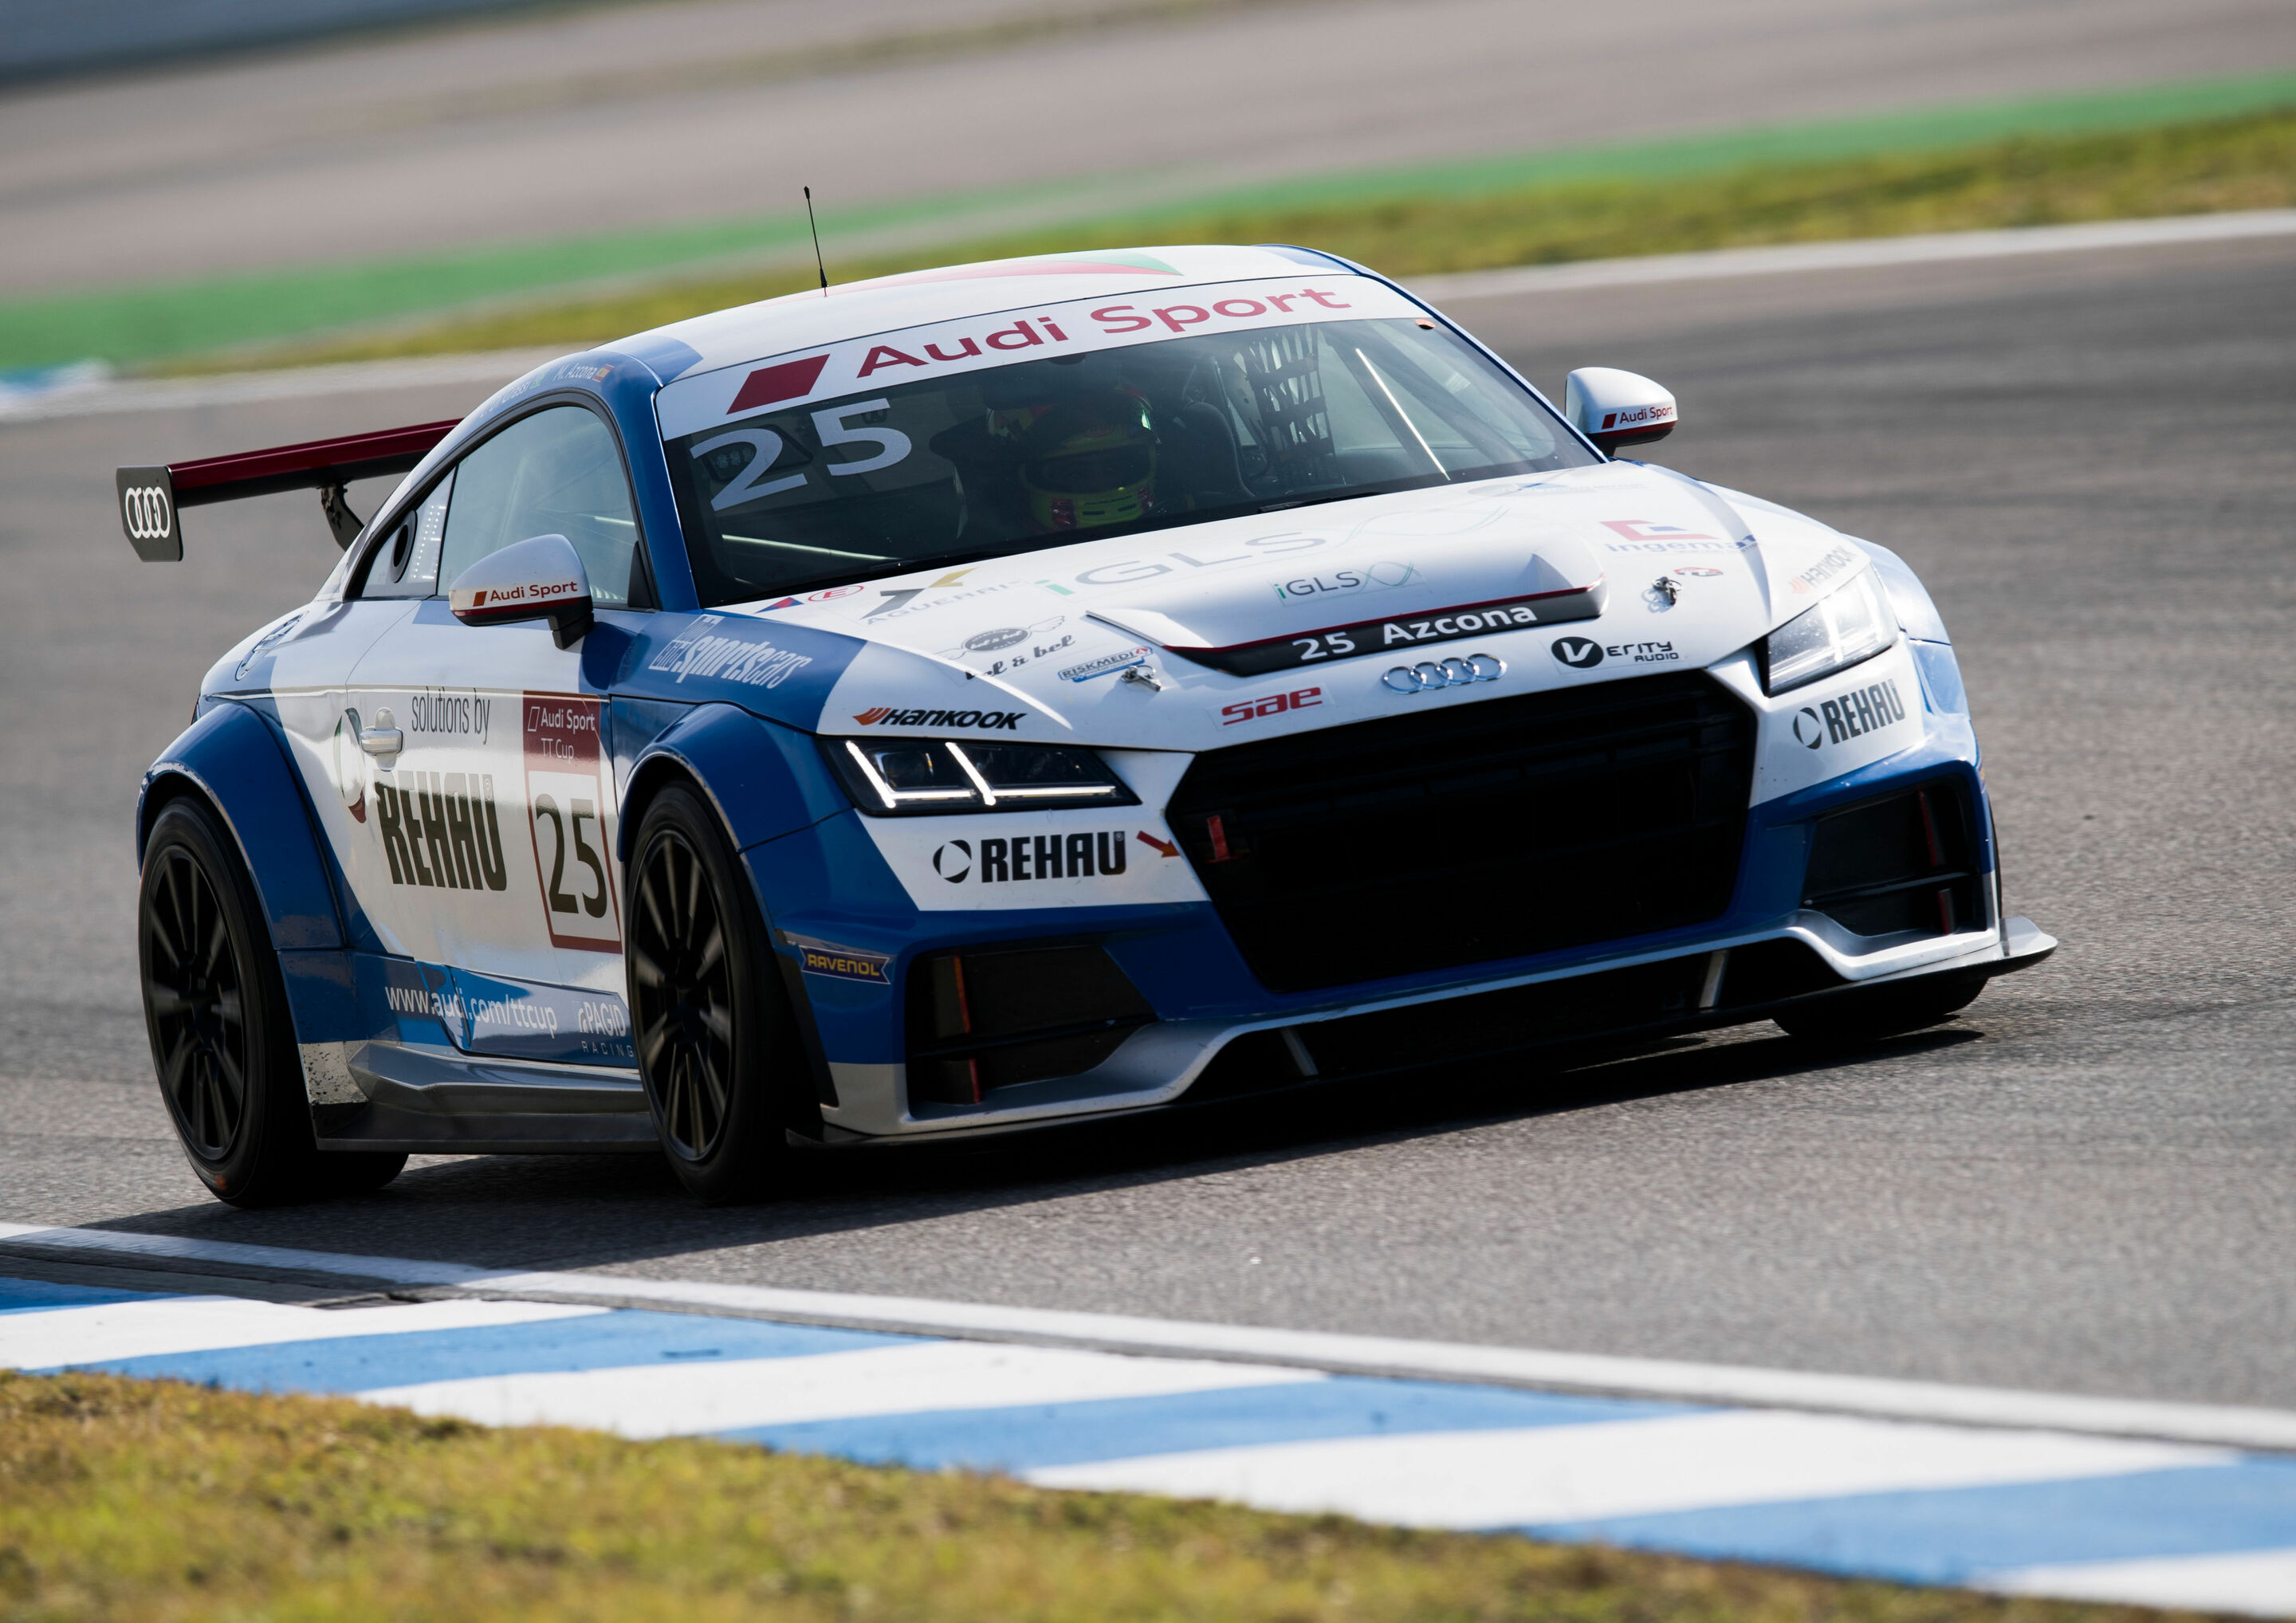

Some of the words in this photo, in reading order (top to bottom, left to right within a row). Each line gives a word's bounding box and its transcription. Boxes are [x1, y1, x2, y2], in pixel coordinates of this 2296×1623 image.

[856, 316, 1069, 379] Audi
[1090, 288, 1352, 333] Sport
[567, 363, 598, 380] Azcona
[1619, 408, 1648, 424] Audi
[1649, 406, 1673, 420] Sport
[689, 398, 913, 512] 25
[1035, 531, 1327, 596] iGLS
[490, 586, 525, 602] Audi
[529, 581, 579, 599] Sport
[1273, 570, 1362, 599] iGLS
[1012, 655, 1029, 668] &
[1033, 635, 1076, 658] bel
[1291, 632, 1356, 662] 25
[1382, 607, 1538, 645] Azcona
[670, 635, 814, 690] sportscars
[1634, 652, 1680, 662] AUDIO
[411, 686, 470, 734] solutions
[473, 686, 491, 745] by
[540, 705, 563, 728] Audi
[565, 708, 596, 733] Sport
[1221, 686, 1323, 726] sae
[1820, 683, 1906, 745] REHAU
[541, 737, 554, 758] TT
[555, 739, 575, 762] Cup
[373, 769, 508, 892] REHAU
[536, 793, 608, 918] 25
[980, 831, 1127, 883] REHAU
[807, 953, 882, 977] RAVENOL
[385, 985, 558, 1041] www.audi.com/ttcup
[584, 1001, 627, 1037] PAGID
[581, 1040, 635, 1058] RACING
